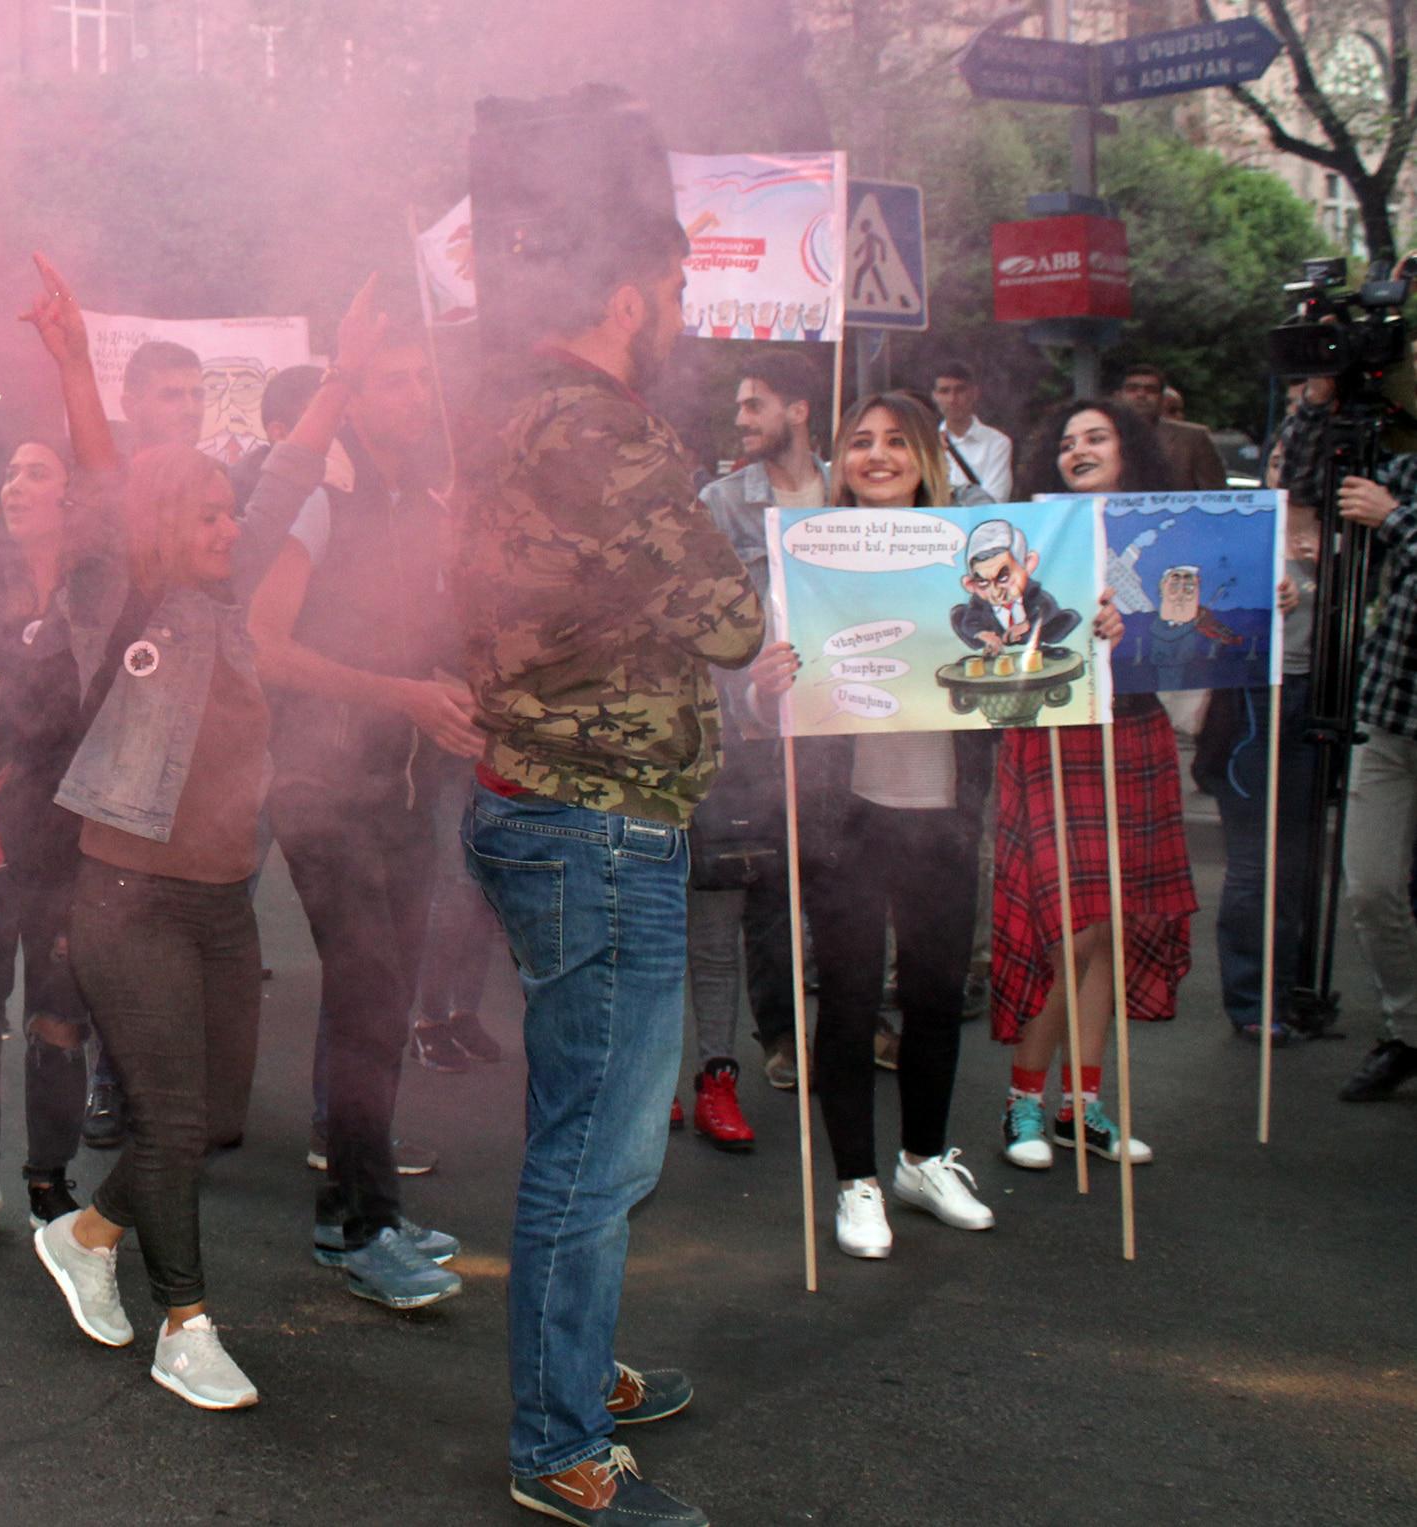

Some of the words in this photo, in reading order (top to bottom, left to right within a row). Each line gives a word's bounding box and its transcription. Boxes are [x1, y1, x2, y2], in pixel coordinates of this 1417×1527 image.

[1139, 58, 1232, 88] ADAMYAN
[1037, 252, 1081, 272] ABB
[804, 522, 822, 534] Ես
[827, 524, 861, 534] սուտ
[865, 522, 887, 537] չեմ
